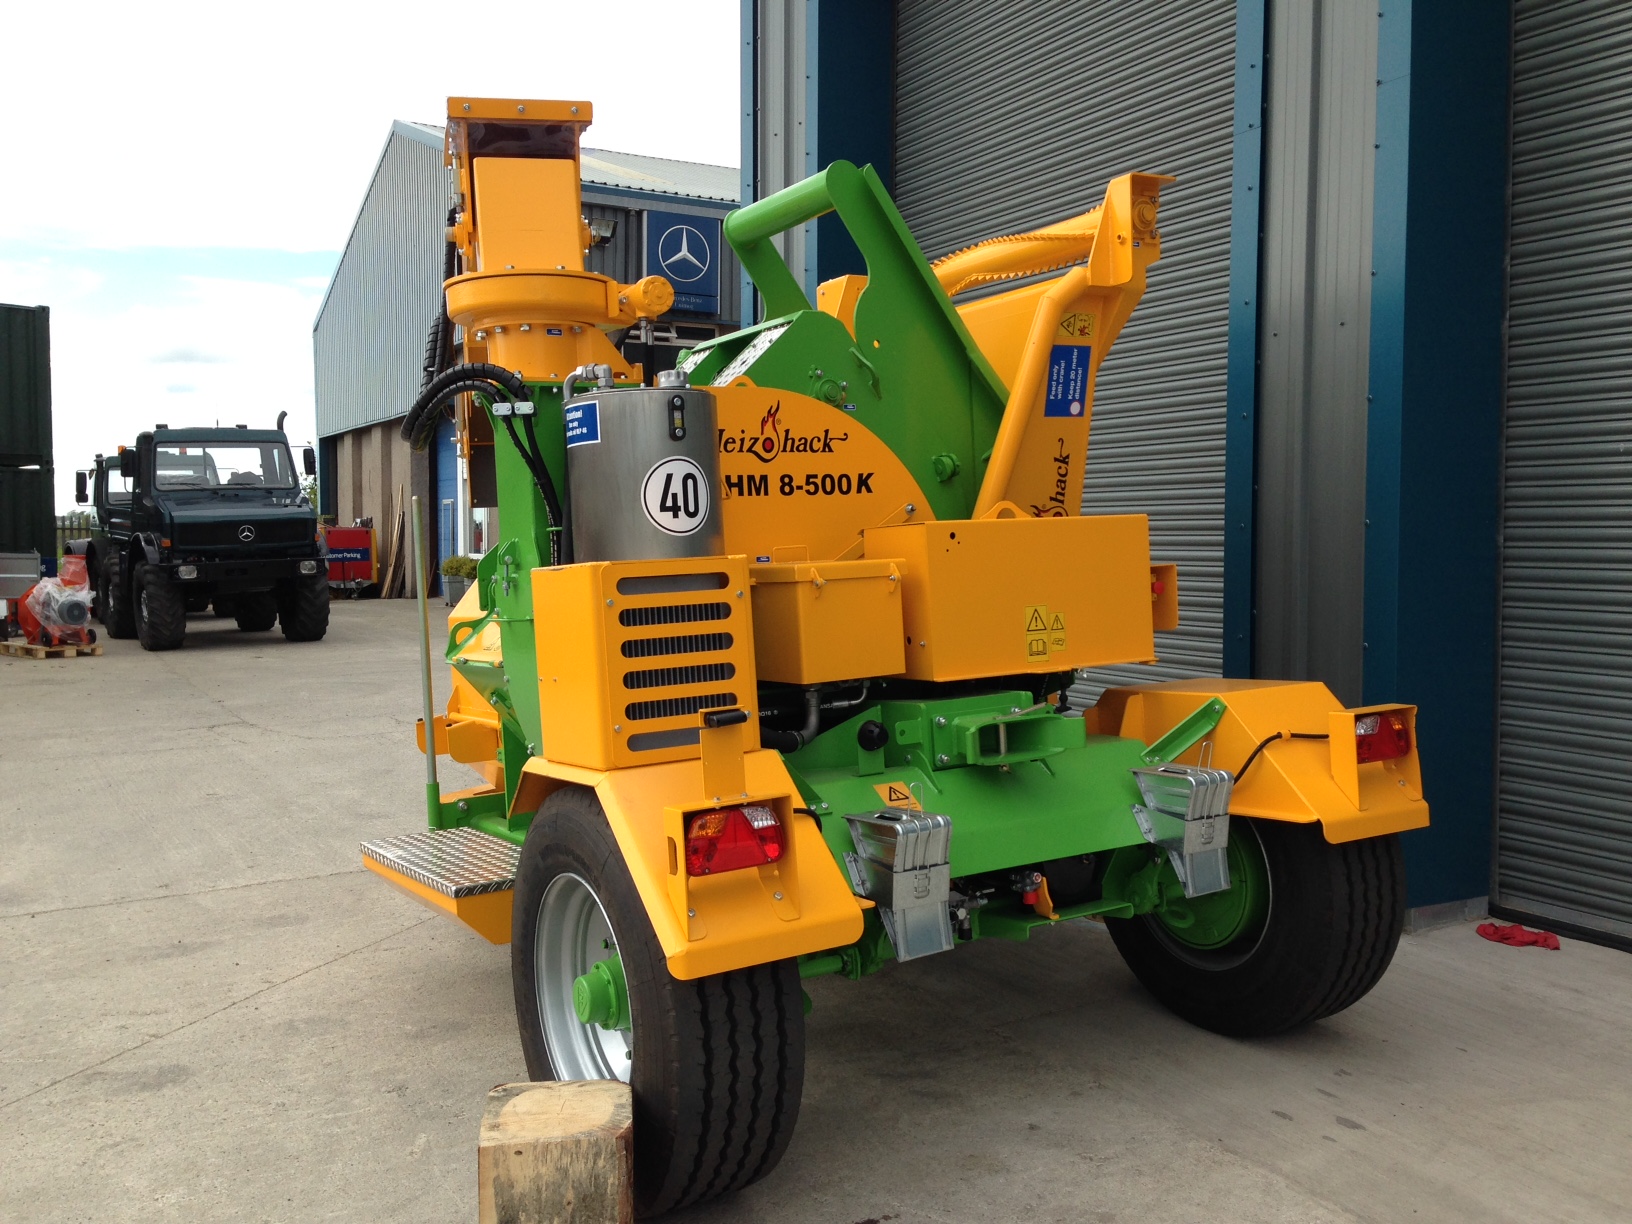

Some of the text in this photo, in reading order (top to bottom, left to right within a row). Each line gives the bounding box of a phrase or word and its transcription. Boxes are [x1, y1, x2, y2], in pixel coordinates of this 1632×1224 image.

[1070, 370, 1076, 380] 20
[659, 472, 700, 519] 40
[725, 474, 769, 496] HM
